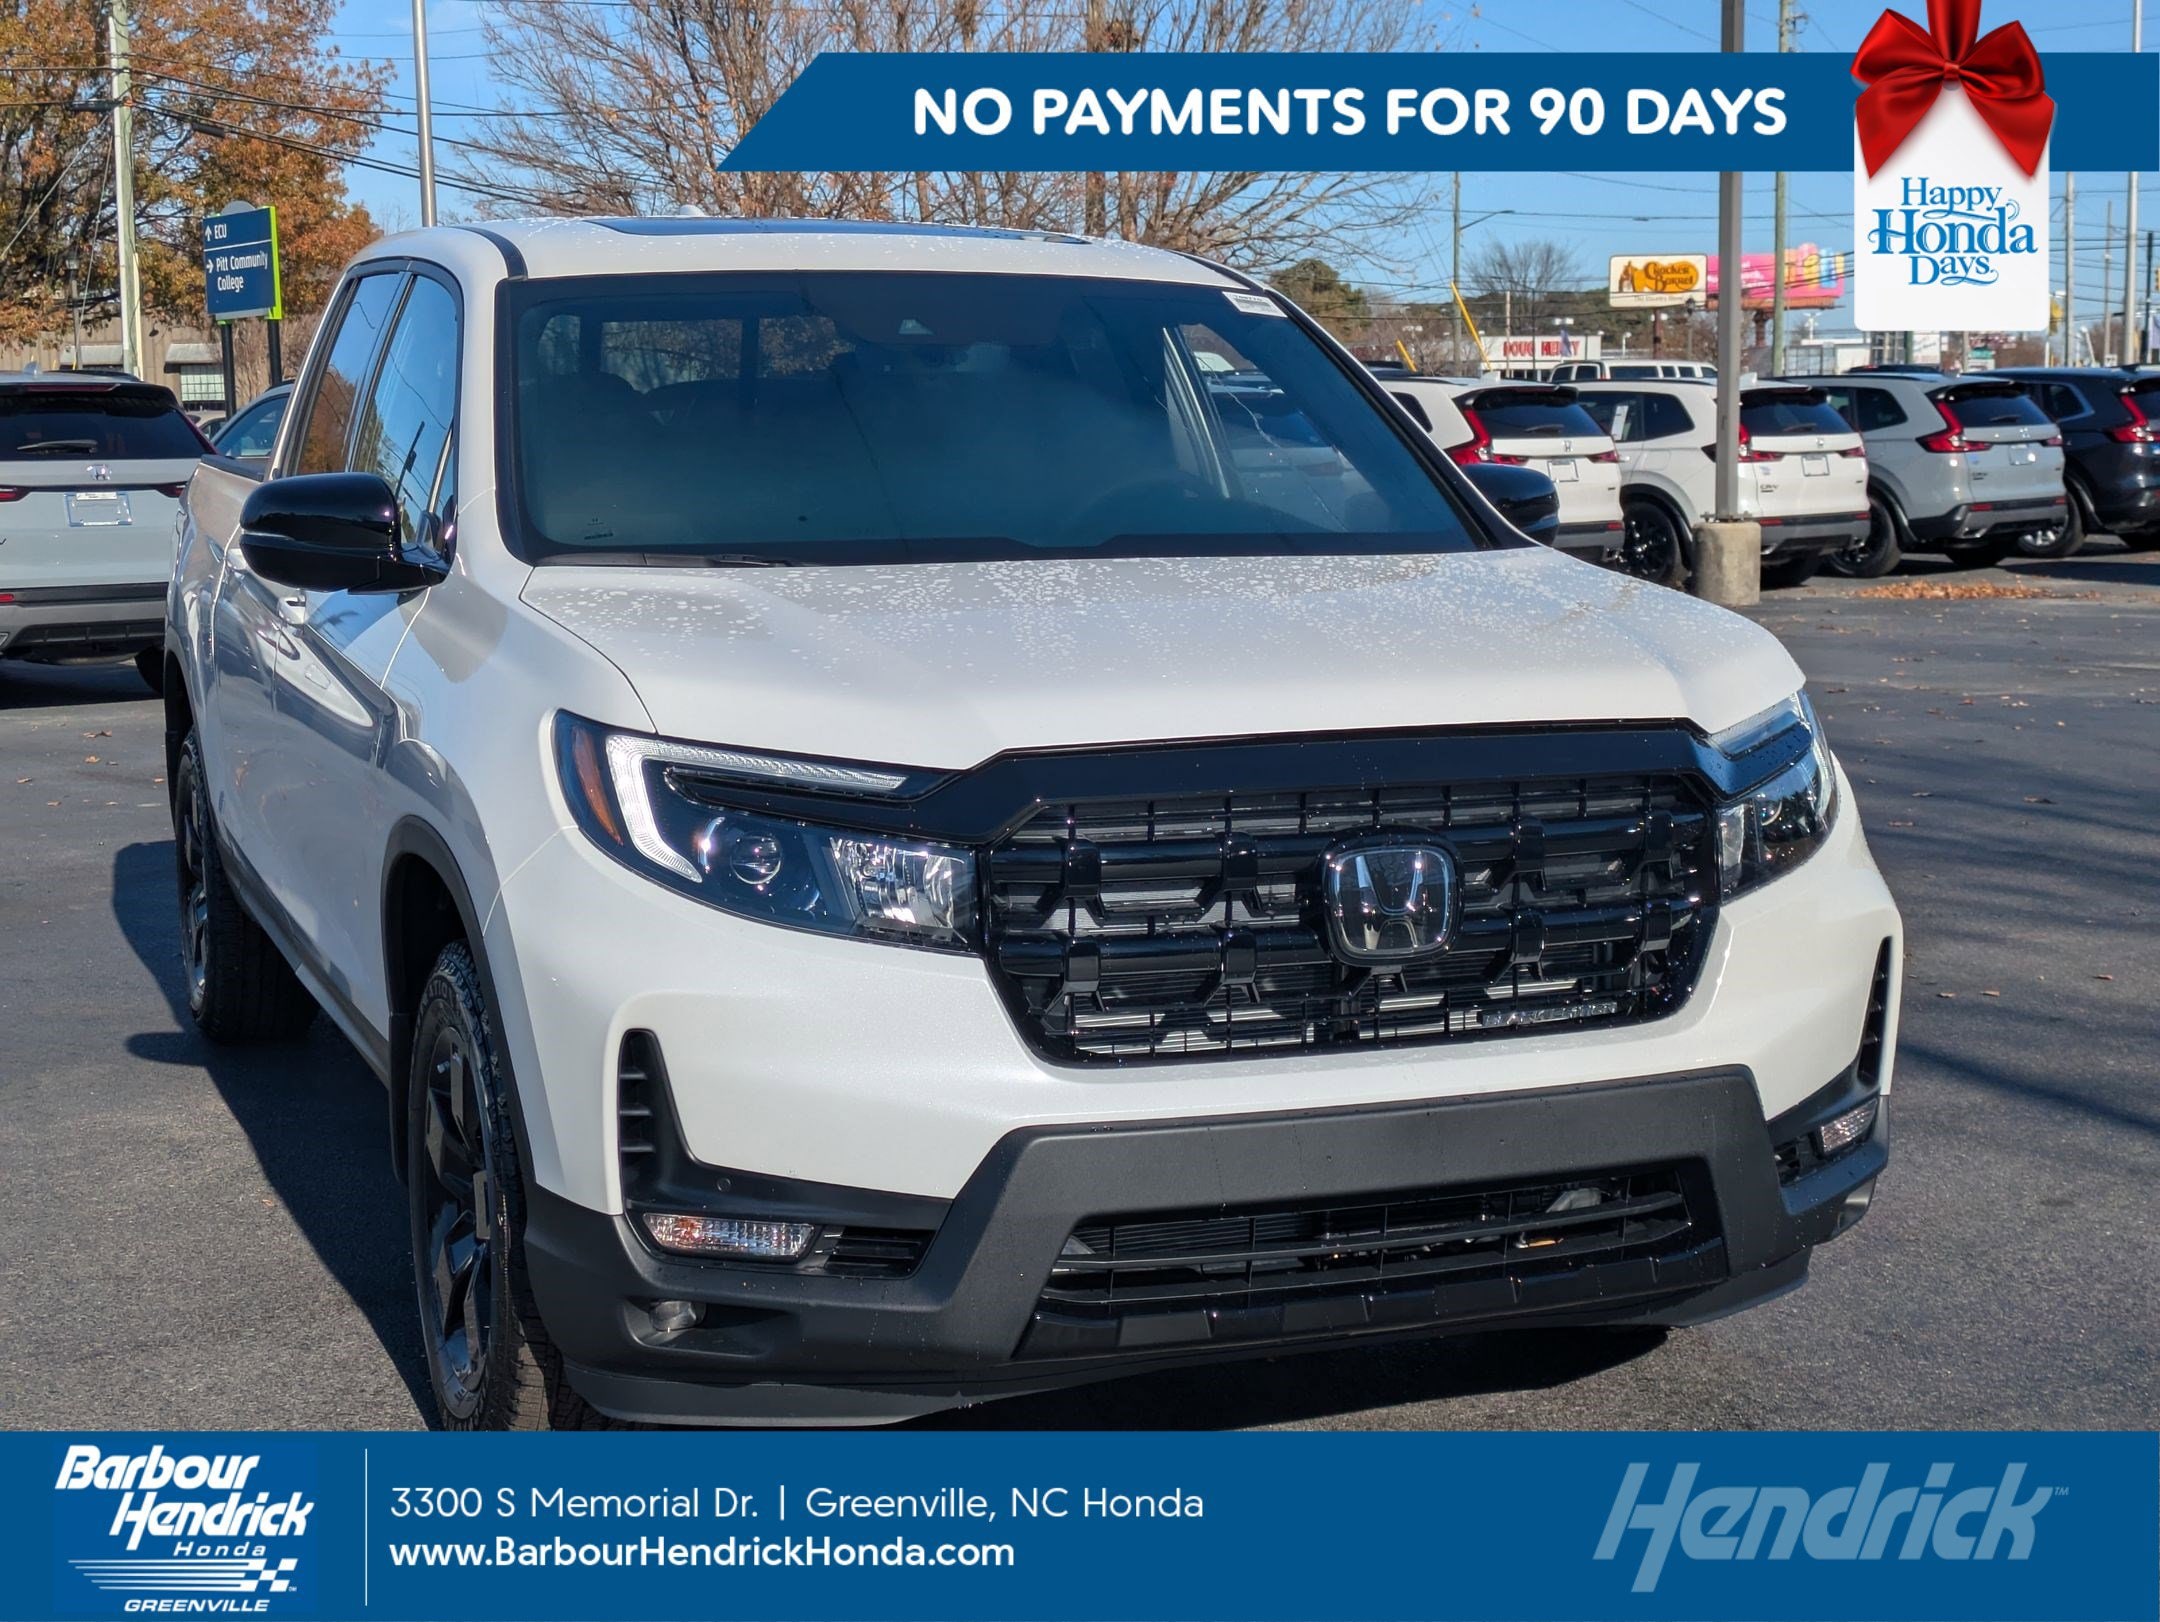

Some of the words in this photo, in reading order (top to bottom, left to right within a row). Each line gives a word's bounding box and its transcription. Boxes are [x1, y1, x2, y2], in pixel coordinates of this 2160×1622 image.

[214, 223, 227, 240] ECU
[216, 256, 229, 272] Pitt
[230, 250, 268, 270] Community
[217, 274, 244, 293] College
